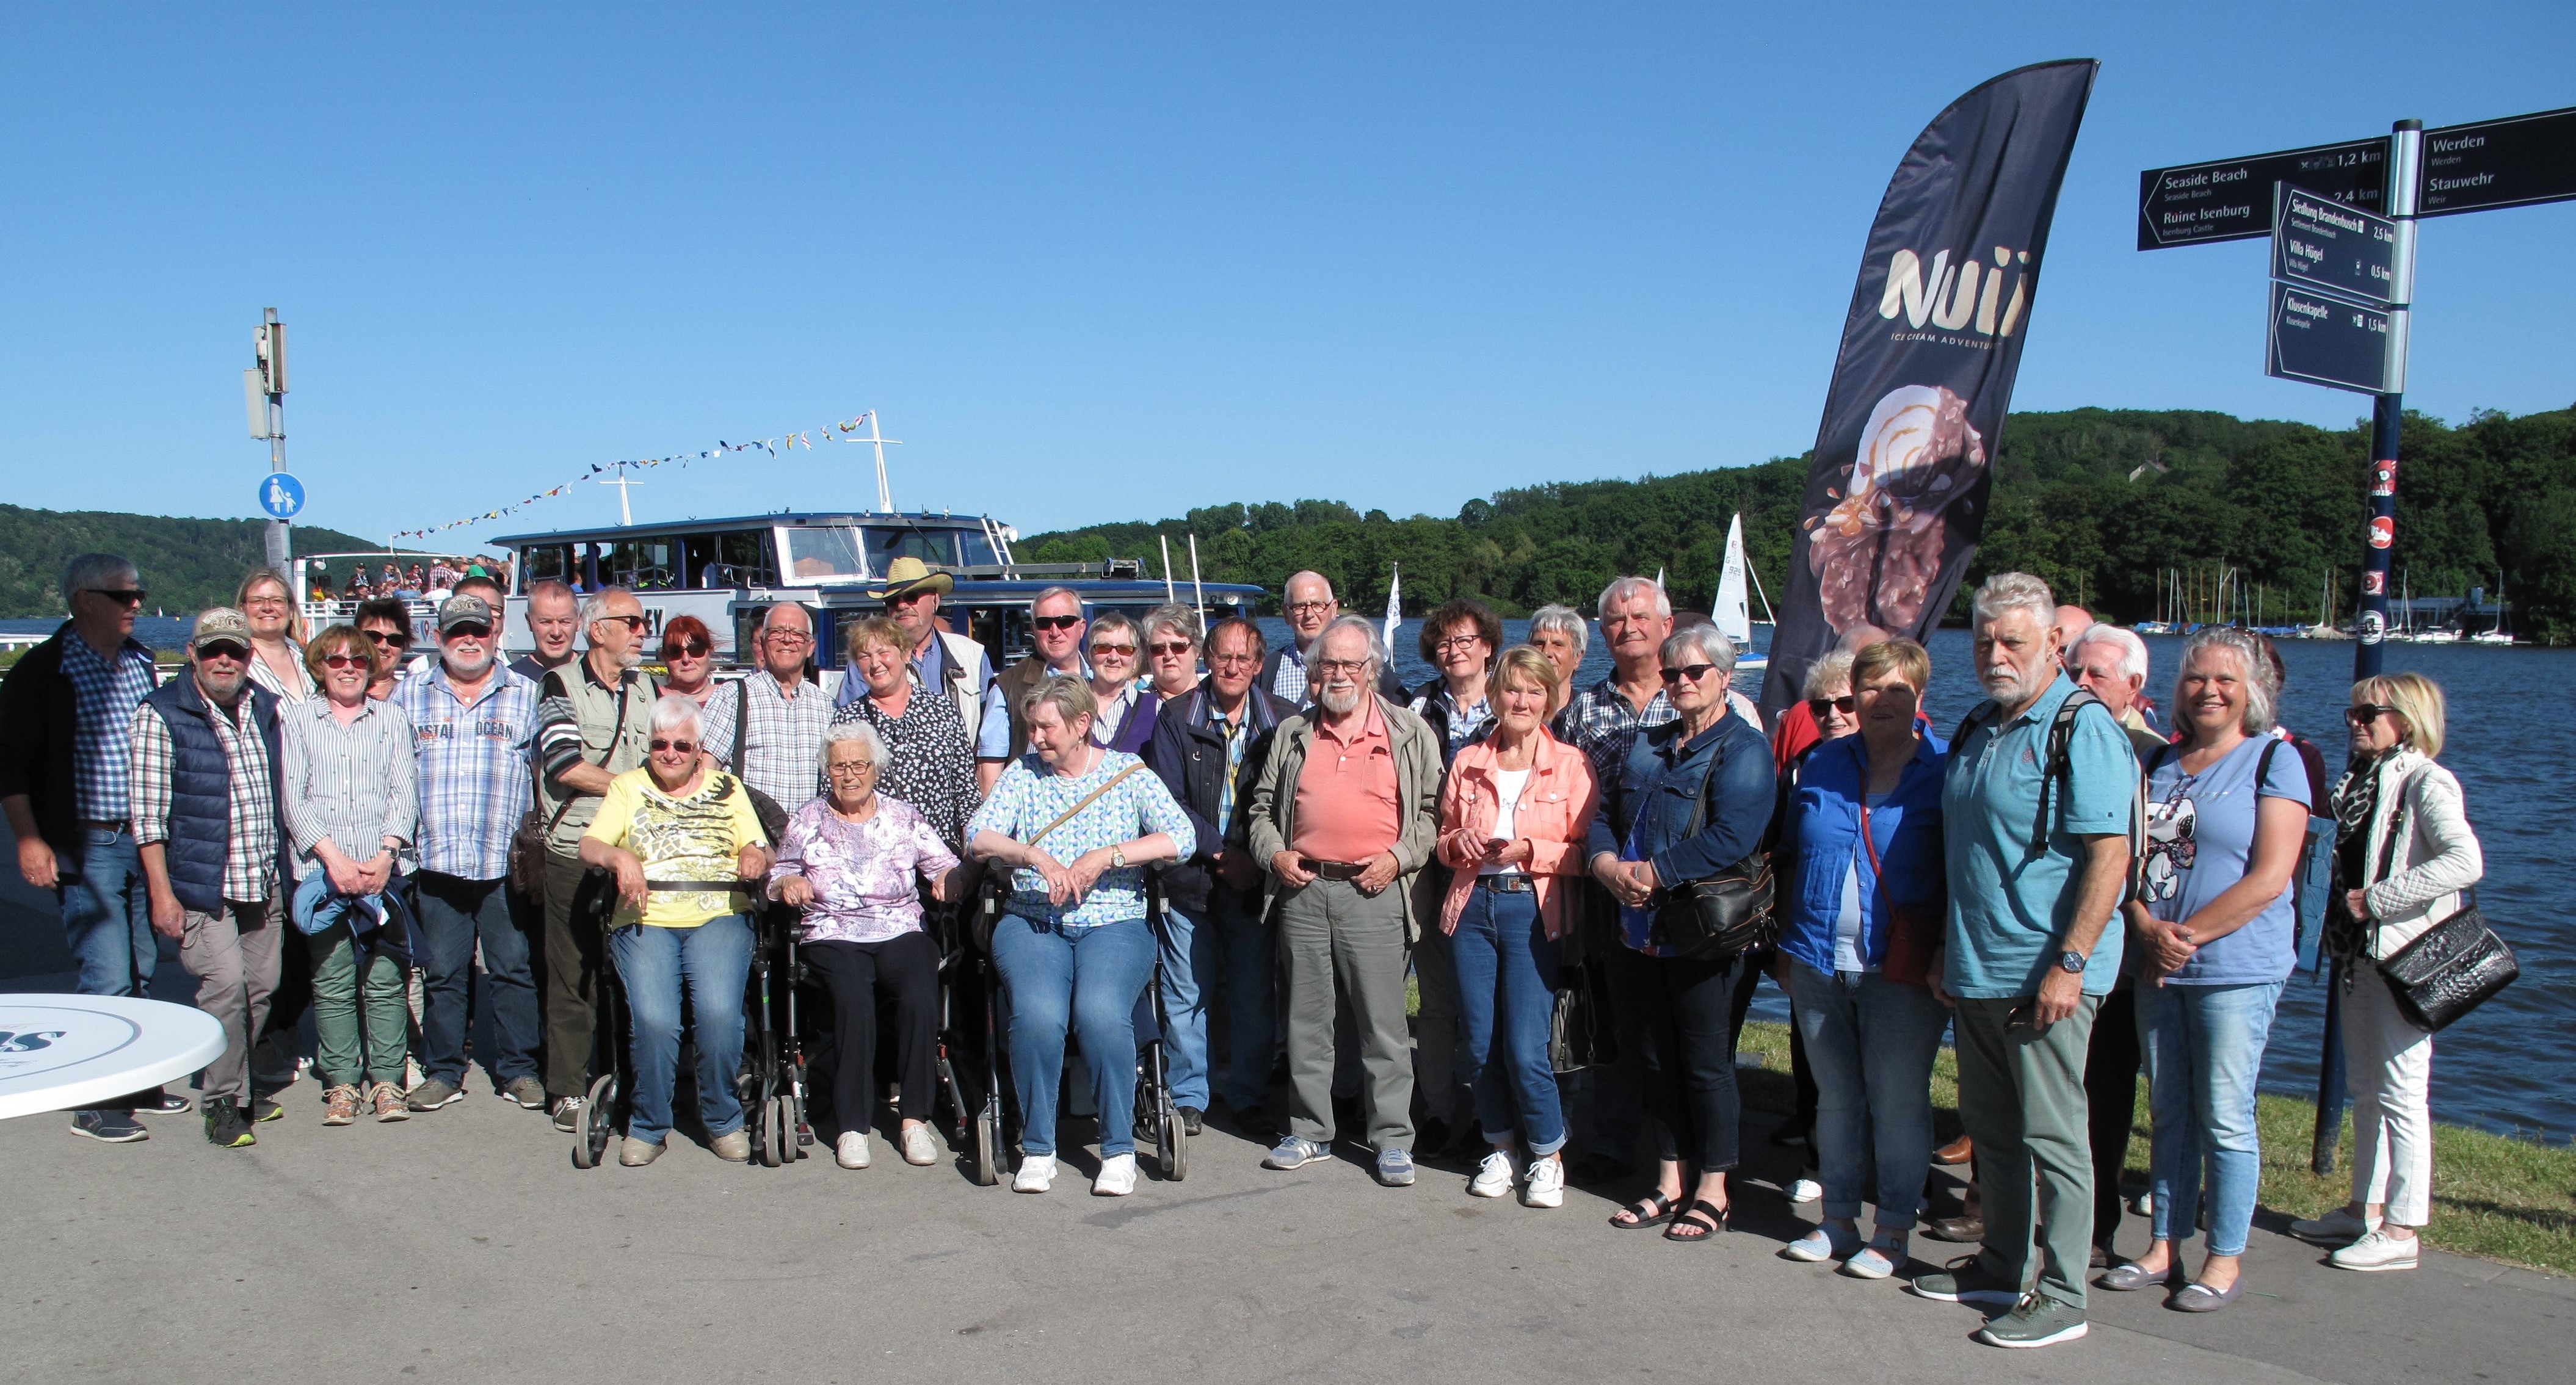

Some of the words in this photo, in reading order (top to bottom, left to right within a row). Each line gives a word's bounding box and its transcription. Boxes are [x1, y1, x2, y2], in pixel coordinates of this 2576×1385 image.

[2433, 136, 2484, 153] Werden
[2338, 154, 2356, 167] 1,2
[2362, 151, 2380, 163] km
[2431, 156, 2461, 166] Werden
[2166, 173, 2208, 189] Seaside
[2213, 168, 2248, 183] Beach
[2429, 173, 2494, 191] Stauwehr
[2164, 192, 2189, 201] Seaside
[2191, 189, 2211, 198] Beach
[2359, 189, 2378, 200] km
[2164, 211, 2196, 224] Ruine
[2200, 205, 2251, 220] Isenburg
[2292, 199, 2318, 223] Siedlung
[2318, 208, 2357, 232] Brandenbusch
[2373, 226, 2383, 240] 2,5
[2384, 229, 2393, 243] km
[2290, 239, 2304, 255] Villa
[2305, 244, 2323, 264] Hügel
[2371, 265, 2381, 278] 0,5
[2382, 267, 2390, 281] km
[2287, 297, 2328, 320] Klusenkapelle
[2368, 318, 2377, 331] 1,5
[2378, 320, 2386, 333] km
[476, 721, 513, 740] OCEAN
